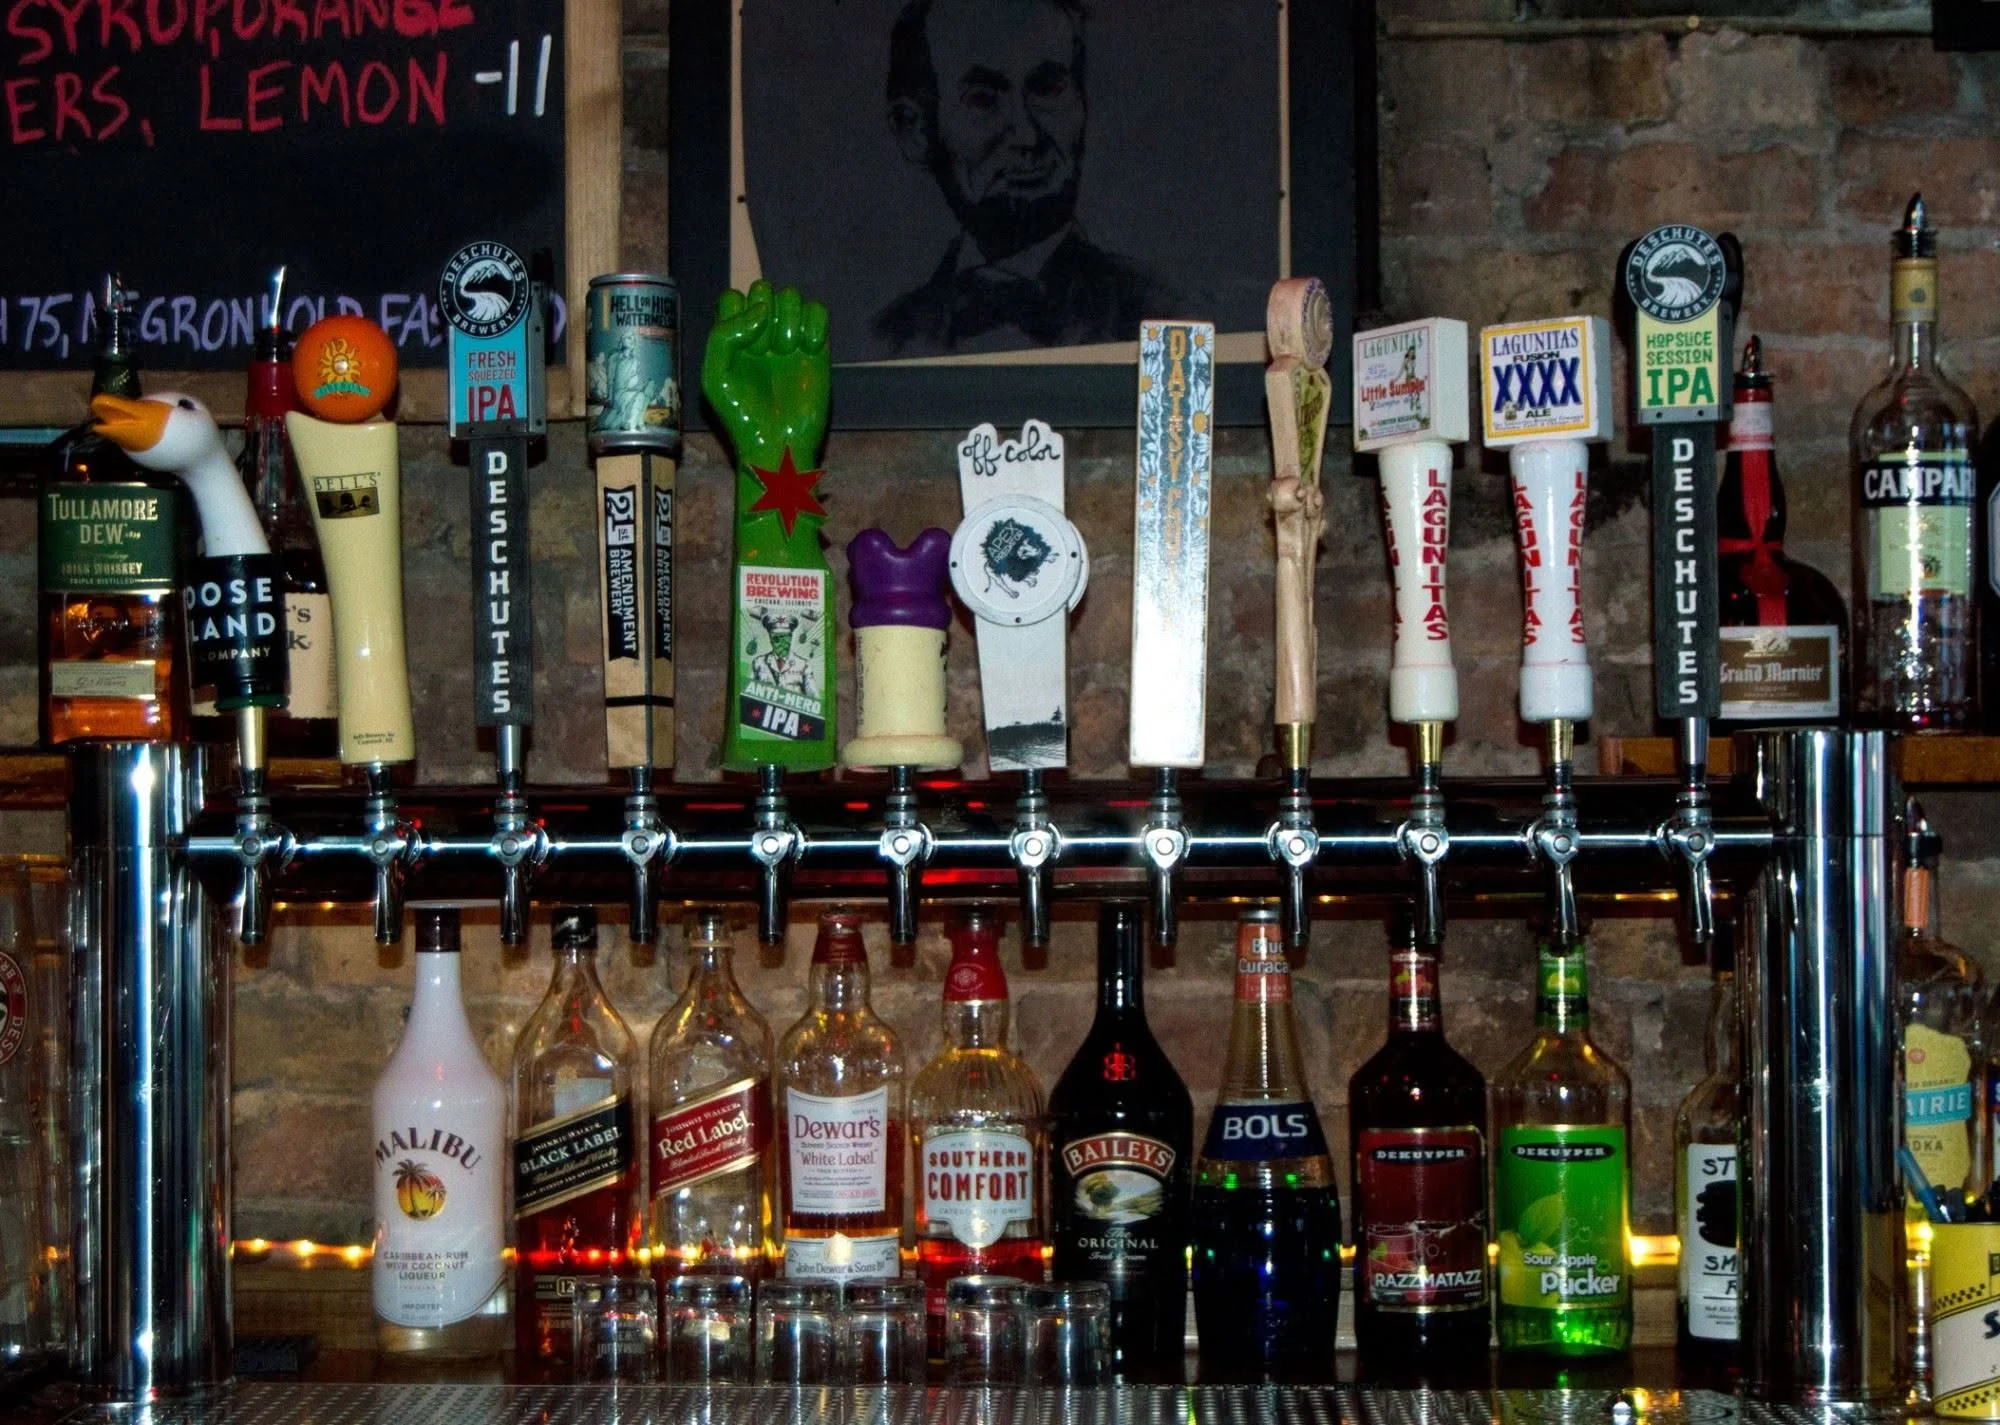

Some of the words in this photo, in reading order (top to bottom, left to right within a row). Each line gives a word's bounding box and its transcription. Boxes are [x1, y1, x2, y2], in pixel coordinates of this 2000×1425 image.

[201, 51, 447, 131] LEMON
[1631, 229, 1721, 266] DESCHUTES
[445, 244, 525, 283] DESCHUTES
[1641, 298, 1712, 319] BREWERY
[453, 312, 516, 335] BREWERY
[1363, 330, 1423, 359] LAGUNITAS
[1492, 327, 1579, 357] LAGUNITAS
[1512, 350, 1561, 363] FUSION
[467, 351, 516, 368] FRESH
[1646, 348, 1713, 367] SESSION
[468, 368, 516, 382] SQUEEZED
[1492, 356, 1582, 413] XXXX
[1646, 365, 1715, 406] IPA
[467, 383, 518, 422] IPA
[1526, 408, 1552, 419] ALE
[962, 433, 1002, 477] off
[1004, 425, 1061, 463] color
[314, 474, 377, 491] BELL'S
[48, 493, 159, 521] TULLAMORE
[1422, 468, 1449, 641] LAGUNITAS
[487, 452, 511, 713] DESCHUTES
[609, 548, 623, 616] BREWERY
[746, 572, 819, 587] REVOLUTION
[1671, 439, 1698, 702] DESCHUTES
[620, 547, 639, 652] AMENDMENT
[661, 547, 673, 652] AMENDMENT
[745, 585, 819, 600] BREWING
[743, 680, 822, 715] ANTI-HERO
[761, 704, 801, 738] IPA
[658, 1130, 699, 1161] Red
[698, 1109, 750, 1145] Label
[794, 1112, 881, 1140] Dewar's
[1222, 1113, 1309, 1141] BOLS
[376, 1126, 483, 1170] MALIBU
[520, 1145, 571, 1175] BLACK
[572, 1125, 623, 1155] LABEL
[928, 1150, 1027, 1169] SOUTHERN
[1070, 1139, 1169, 1168] BAILEYS
[1376, 1148, 1467, 1161] DEKUYPER
[1516, 1145, 1607, 1158] DEKUYPER
[928, 1171, 1029, 1201] COMFORT
[383, 1251, 442, 1262] CARIBBEAN
[446, 1250, 470, 1261] RUM
[1078, 1238, 1159, 1250] ORIGINAL
[412, 1261, 466, 1271] COCONUT
[1523, 1251, 1554, 1266] Sour
[1556, 1253, 1598, 1269] Apple
[399, 1271, 447, 1281] LIQUEUR
[1375, 1269, 1482, 1289] RAZZMATAZZ
[1541, 1266, 1621, 1297] Pucker
